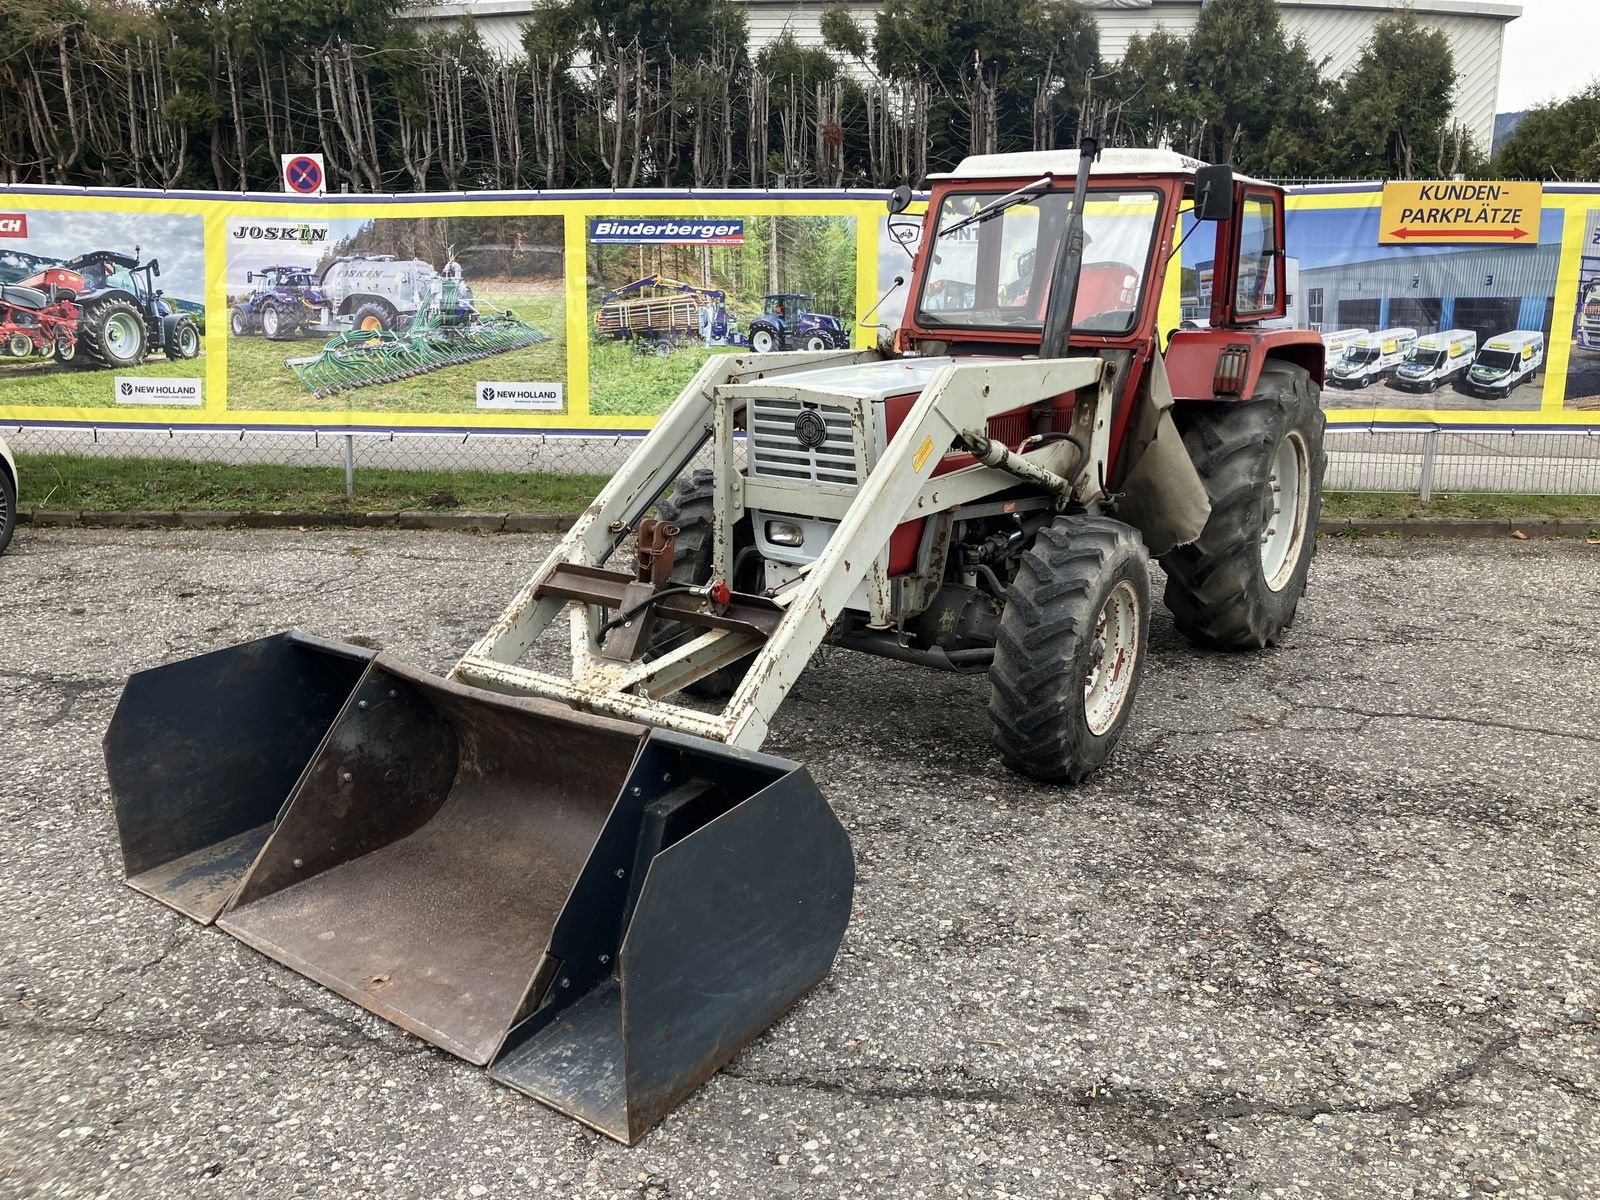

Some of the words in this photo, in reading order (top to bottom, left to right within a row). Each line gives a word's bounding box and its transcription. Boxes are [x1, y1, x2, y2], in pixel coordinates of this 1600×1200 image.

[1419, 185, 1510, 201] KUNDEN-
[1400, 202, 1523, 224] PARKPLÄTZE
[233, 225, 329, 242] JOSKIN
[595, 222, 741, 239] Binderberger
[1412, 279, 1419, 288] 2
[1485, 275, 1494, 286] 3
[156, 386, 196, 394] HOLLAND
[517, 391, 557, 399] HOLLAND
